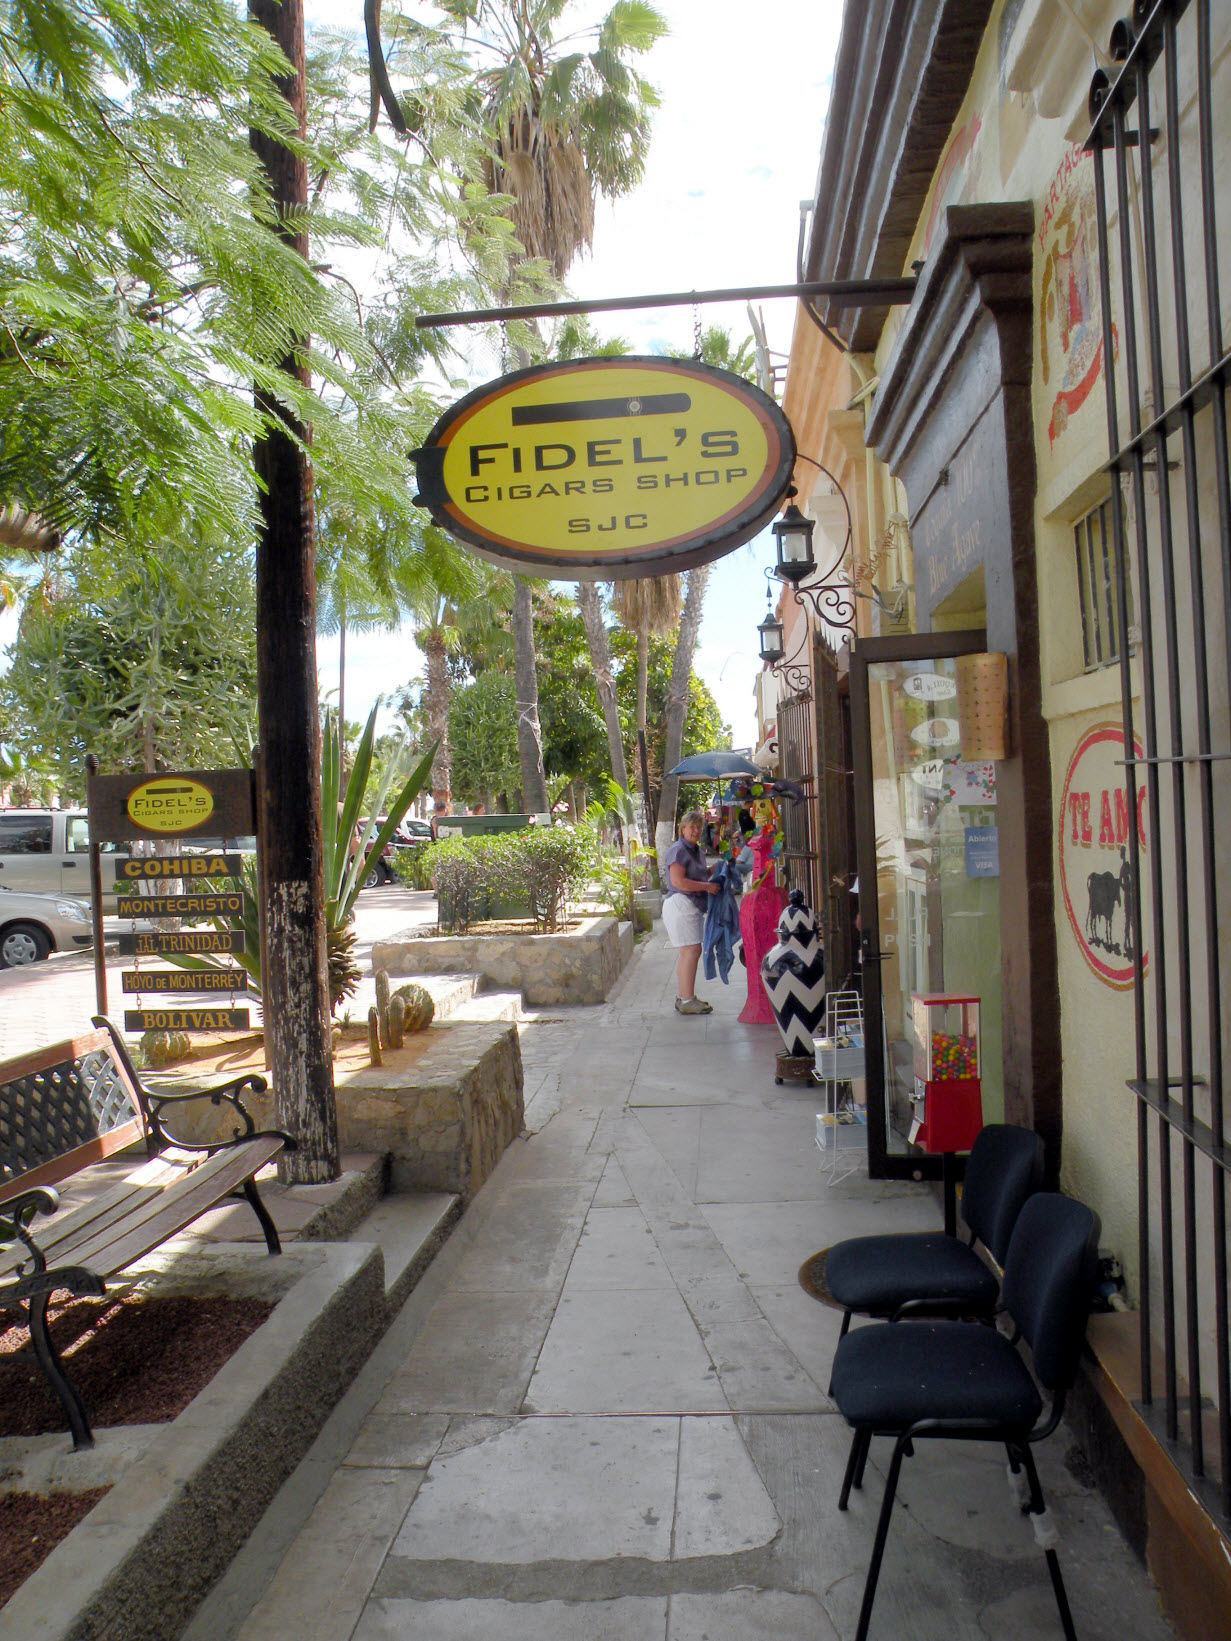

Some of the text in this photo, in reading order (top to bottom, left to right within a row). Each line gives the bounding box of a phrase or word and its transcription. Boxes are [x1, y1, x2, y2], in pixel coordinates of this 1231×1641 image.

[1038, 142, 1094, 254] PARTAG
[468, 428, 740, 477] FIDEL'S
[465, 467, 748, 503] CIGARS SHOP
[567, 513, 649, 534] SJC
[134, 796, 207, 808] FIDEL'S
[133, 807, 209, 817] CIGARS SHOP
[160, 819, 183, 827] SJC
[124, 858, 229, 877] COHIBA
[975, 860, 994, 869] VISA
[119, 897, 240, 914] MONTECRISTO
[158, 934, 233, 951] TRINIDAD
[124, 975, 154, 990] HOYO
[169, 973, 243, 989] MONTERREY
[143, 1012, 235, 1030] BOLIVAR
